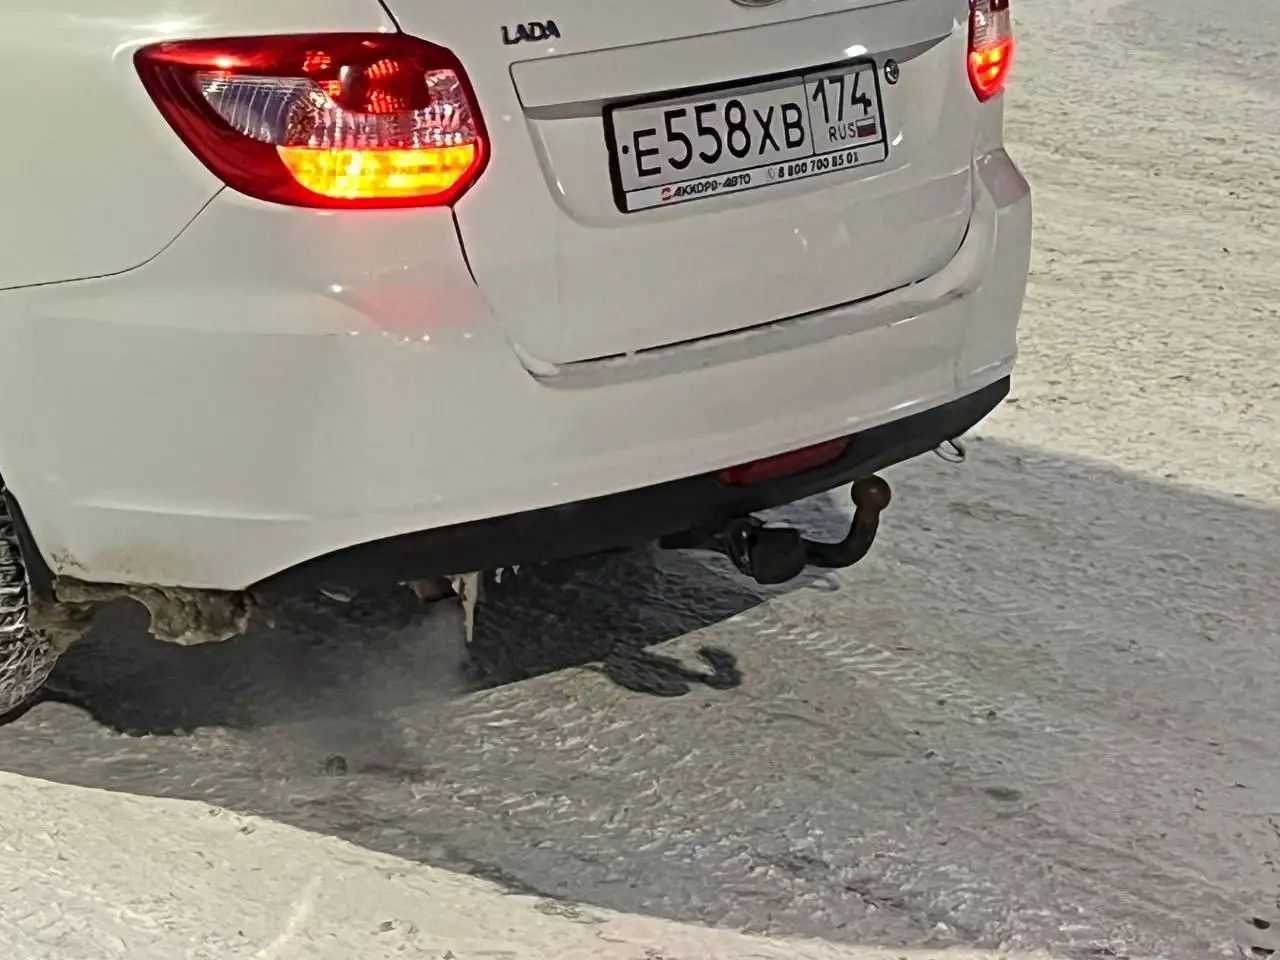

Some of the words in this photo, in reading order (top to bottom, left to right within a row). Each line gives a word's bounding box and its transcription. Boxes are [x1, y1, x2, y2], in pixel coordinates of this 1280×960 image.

[501, 20, 561, 45] LADA
[812, 71, 872, 124] 174
[828, 122, 856, 142] RUS
